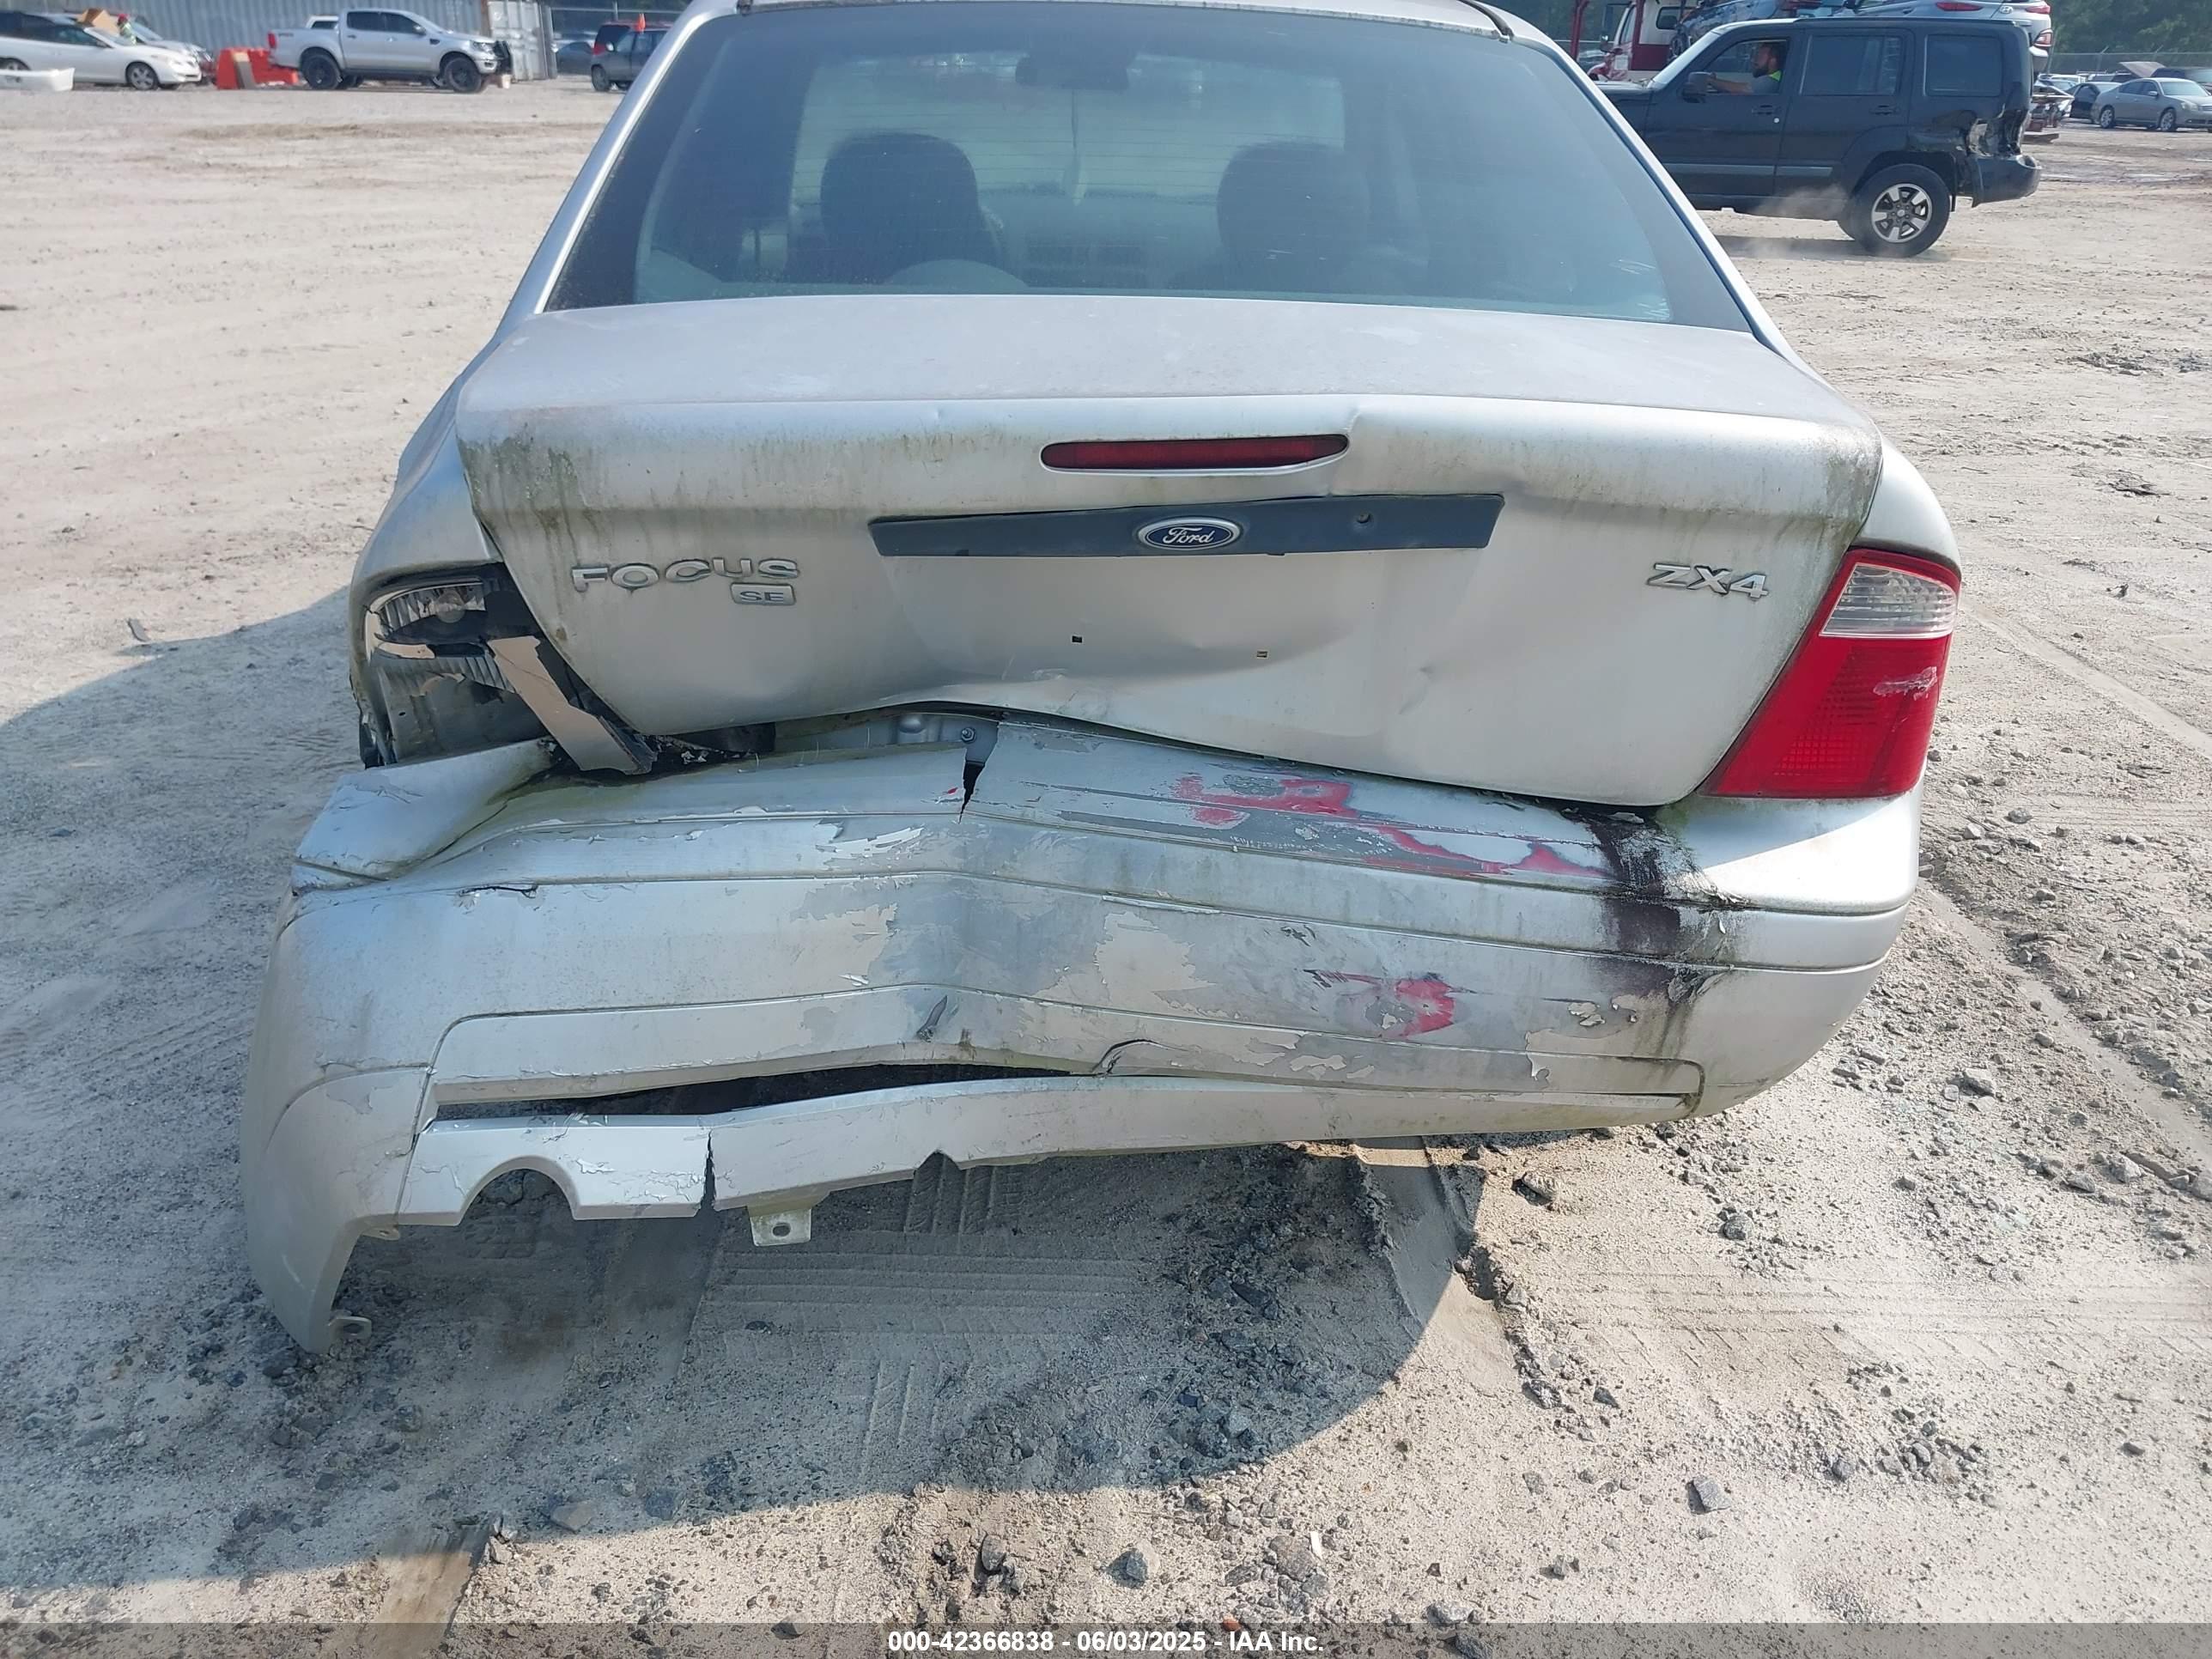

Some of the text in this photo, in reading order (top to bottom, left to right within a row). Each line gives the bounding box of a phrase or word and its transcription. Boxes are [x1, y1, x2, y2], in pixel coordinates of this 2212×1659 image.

[1163, 526, 1215, 544] Ford
[571, 557, 799, 592] FOCUS
[1647, 563, 1769, 599] ZX4
[739, 590, 785, 602] SE
